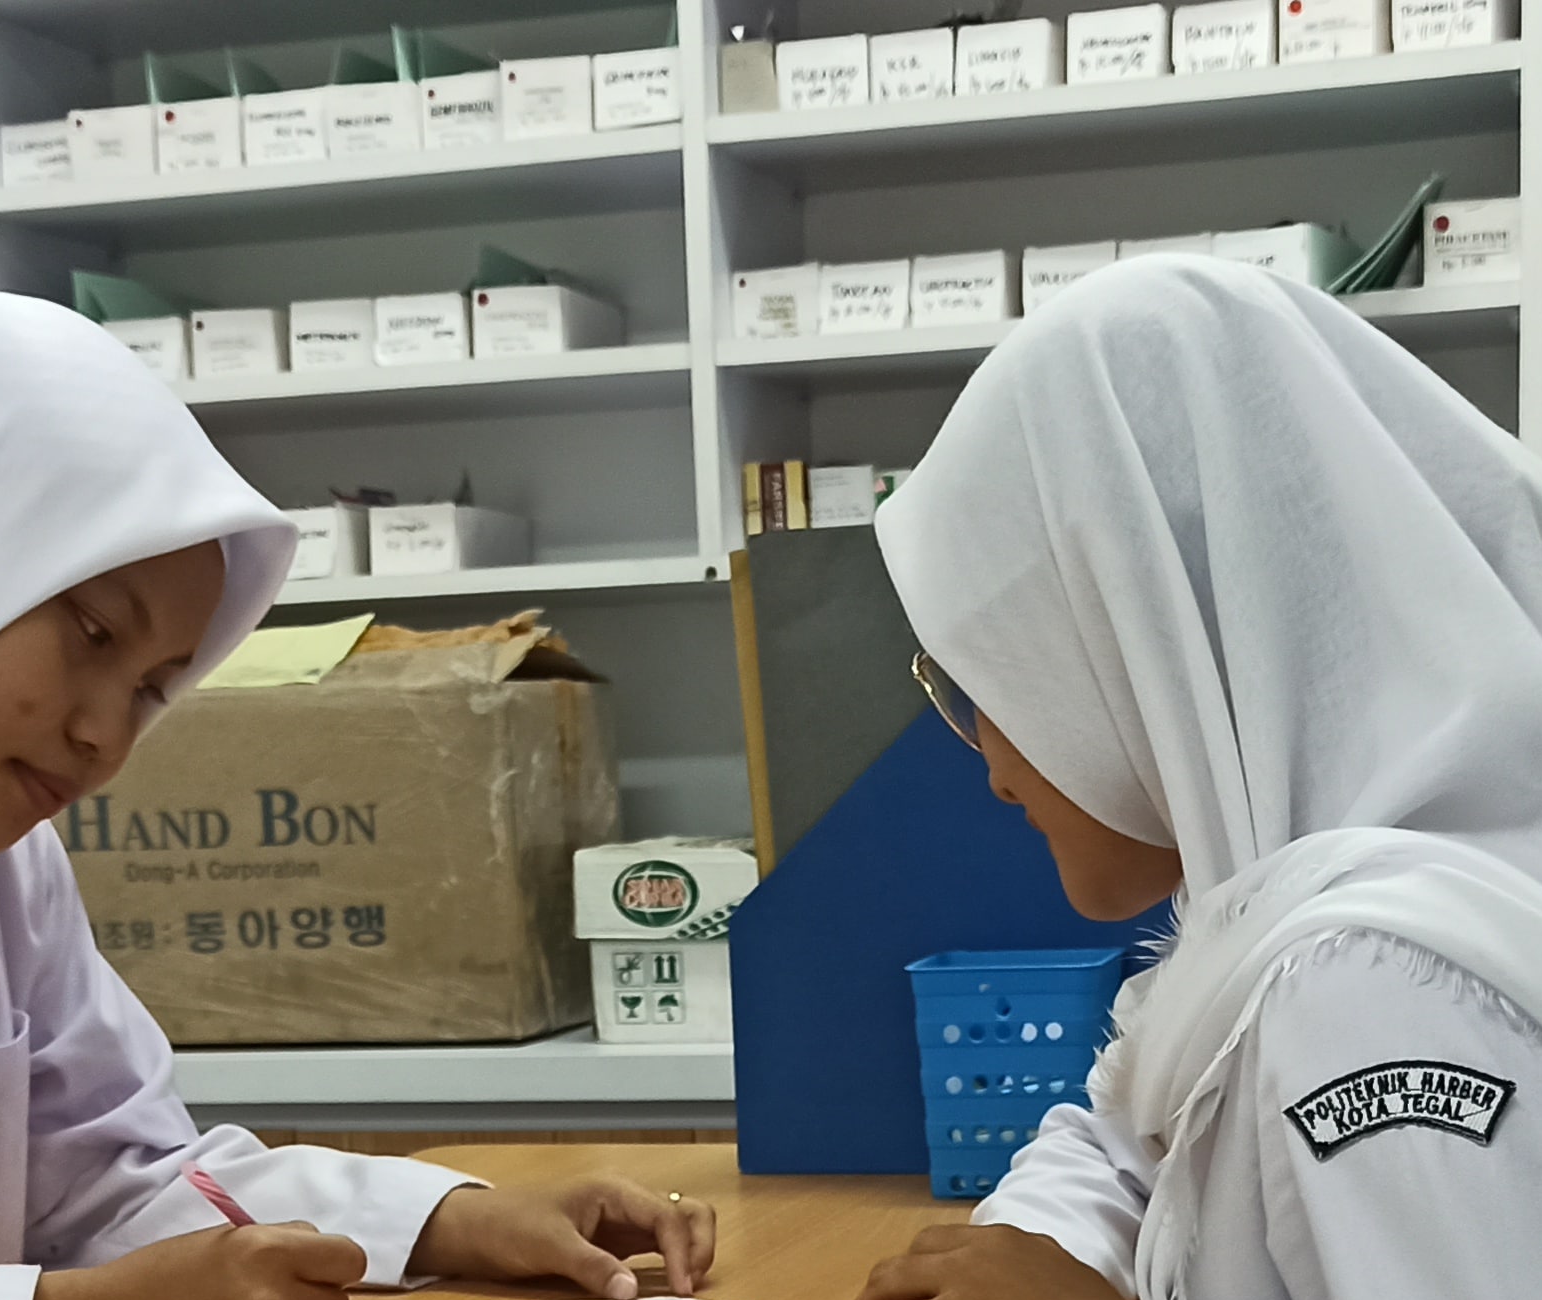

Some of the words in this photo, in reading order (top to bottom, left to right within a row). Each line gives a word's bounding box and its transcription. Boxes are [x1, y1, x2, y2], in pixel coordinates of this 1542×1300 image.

[66, 795, 231, 852] HAND
[256, 788, 377, 848] BON
[125, 861, 199, 884] Dong-A
[207, 859, 320, 882] Corporation
[90, 919, 172, 950] 조원:
[186, 904, 386, 955] 동아양행
[1301, 1071, 1410, 1129] POLITEKNIK
[1421, 1071, 1498, 1111] HARBER
[1333, 1098, 1390, 1134] KOTA
[1401, 1093, 1465, 1122] TEGAL
